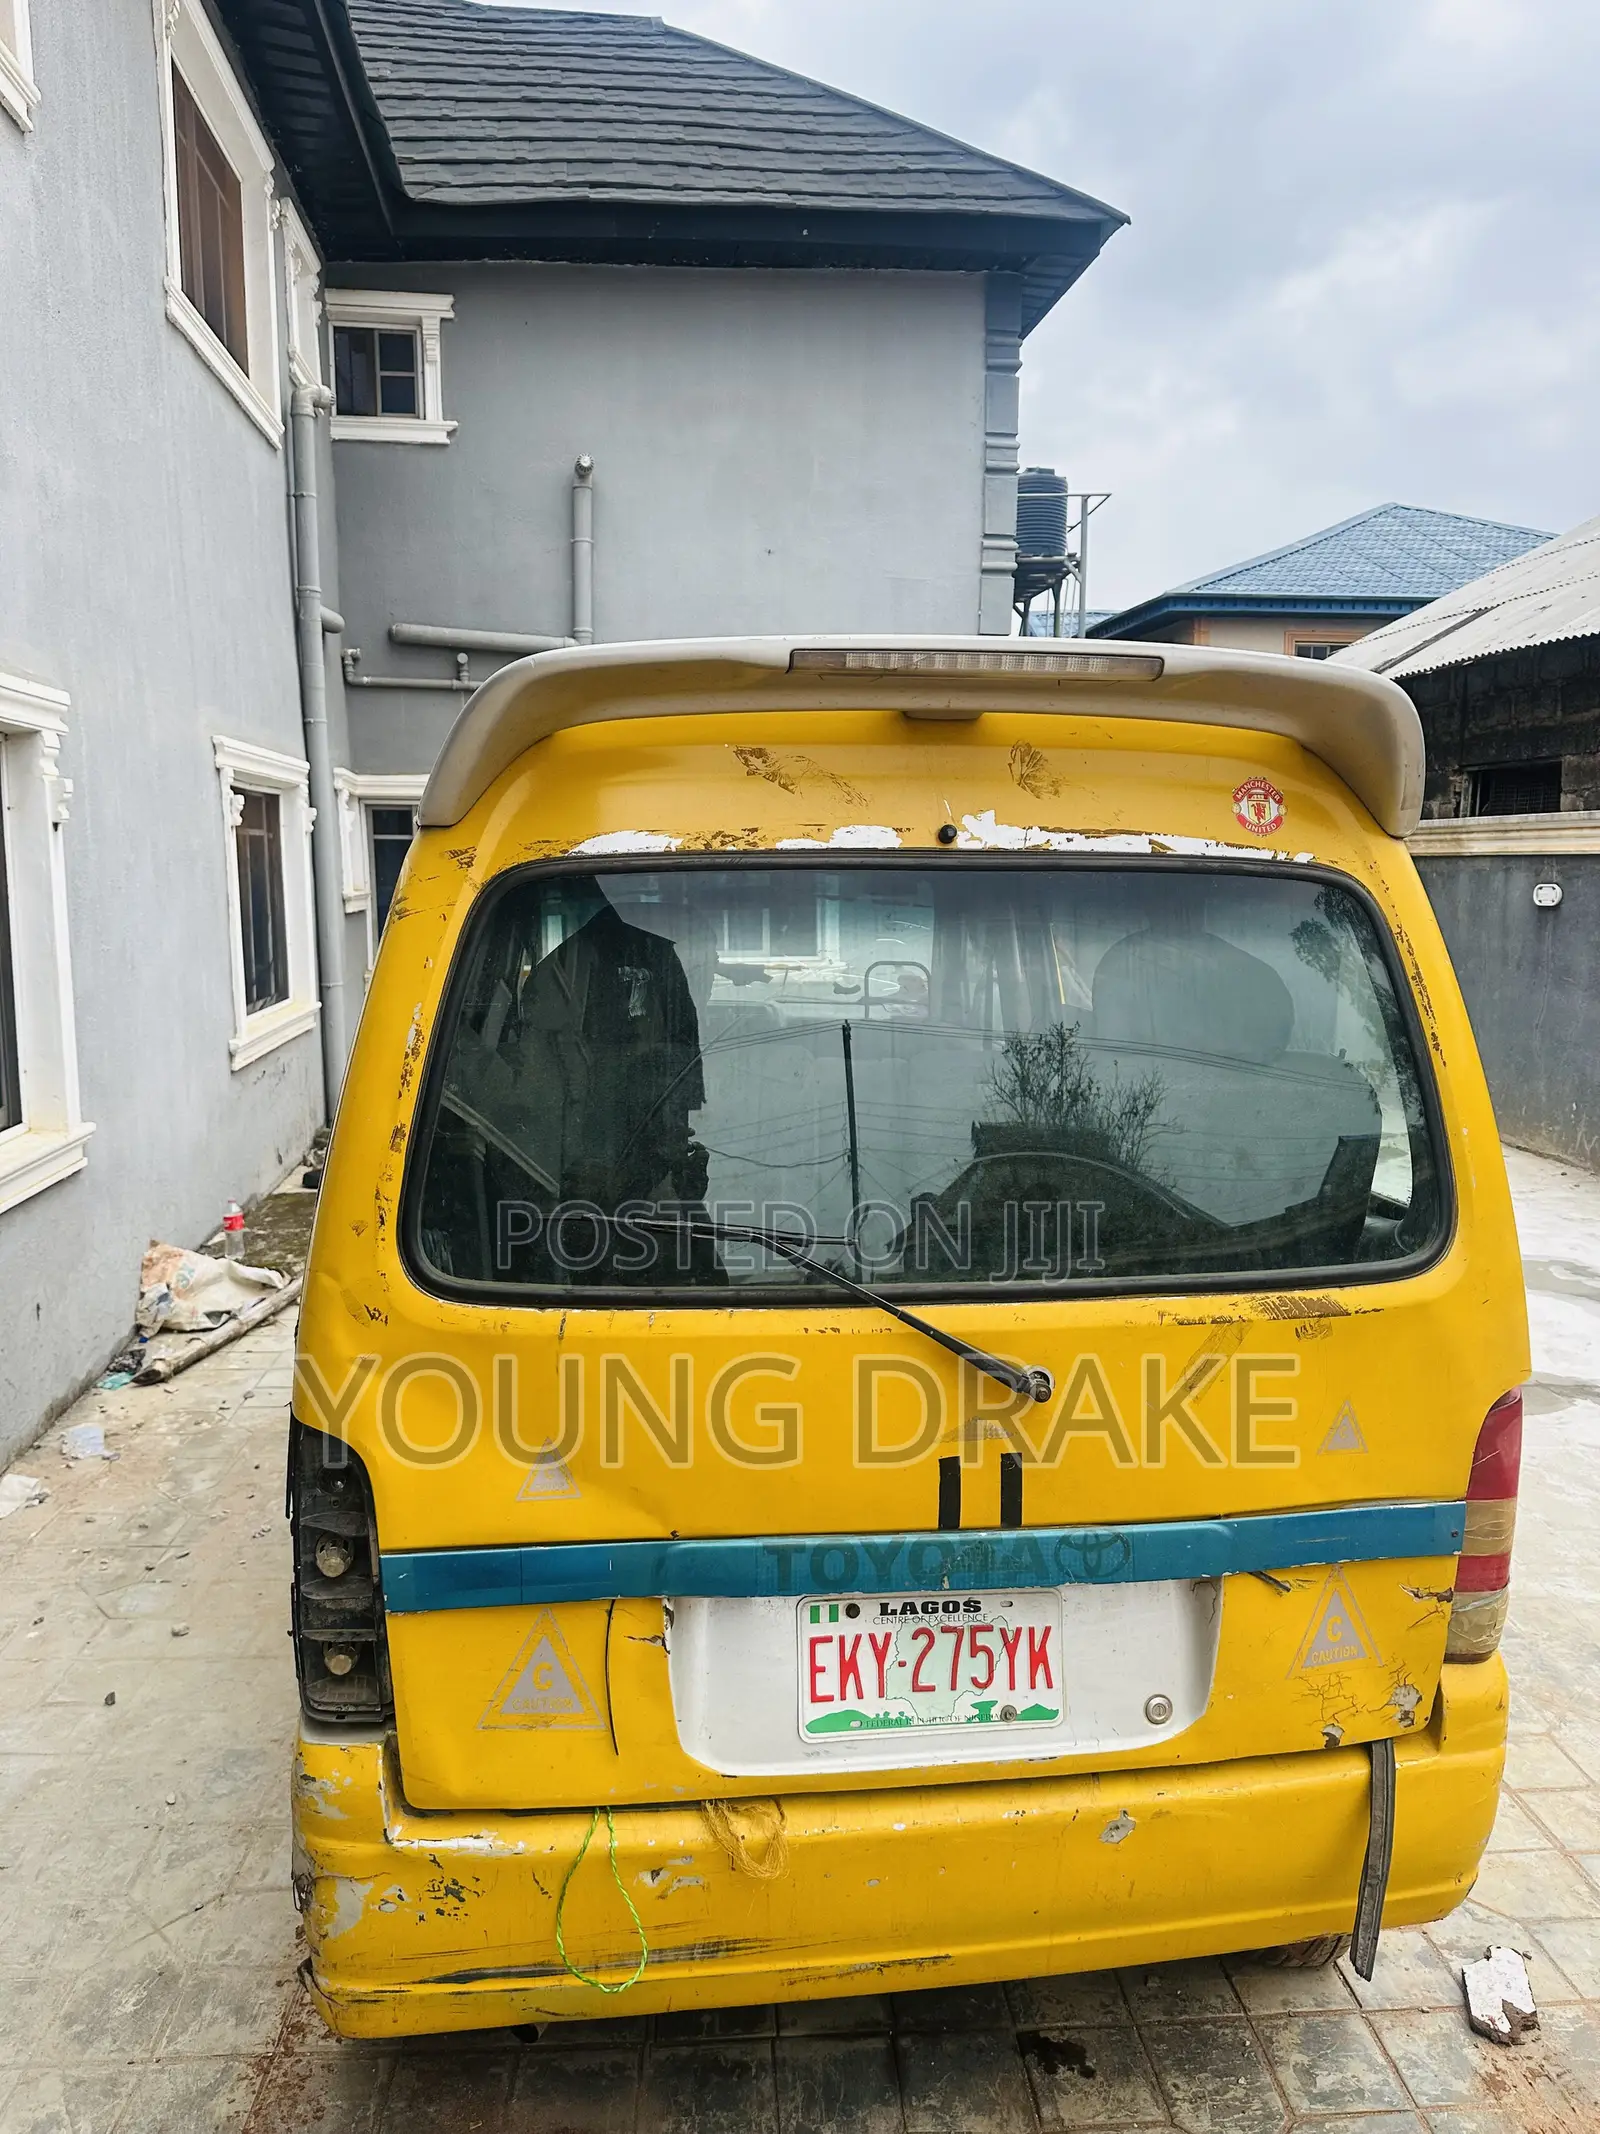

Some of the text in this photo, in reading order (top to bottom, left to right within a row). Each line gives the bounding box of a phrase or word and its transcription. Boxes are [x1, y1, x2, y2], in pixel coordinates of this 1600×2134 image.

[1235, 781, 1280, 801] MANCHESTER
[1245, 822, 1277, 833] UNITED
[880, 1599, 981, 1616] LAGOS
[873, 1613, 988, 1626] CENTRE OF EXCELLENCE
[1327, 1616, 1342, 1642] C
[809, 1625, 1053, 1703] EKY-275YK
[1312, 1645, 1358, 1664] CAUTION
[533, 1662, 552, 1691] C
[866, 1716, 903, 1728] FEDERAL
[964, 1712, 1000, 1722] NIGERIA
